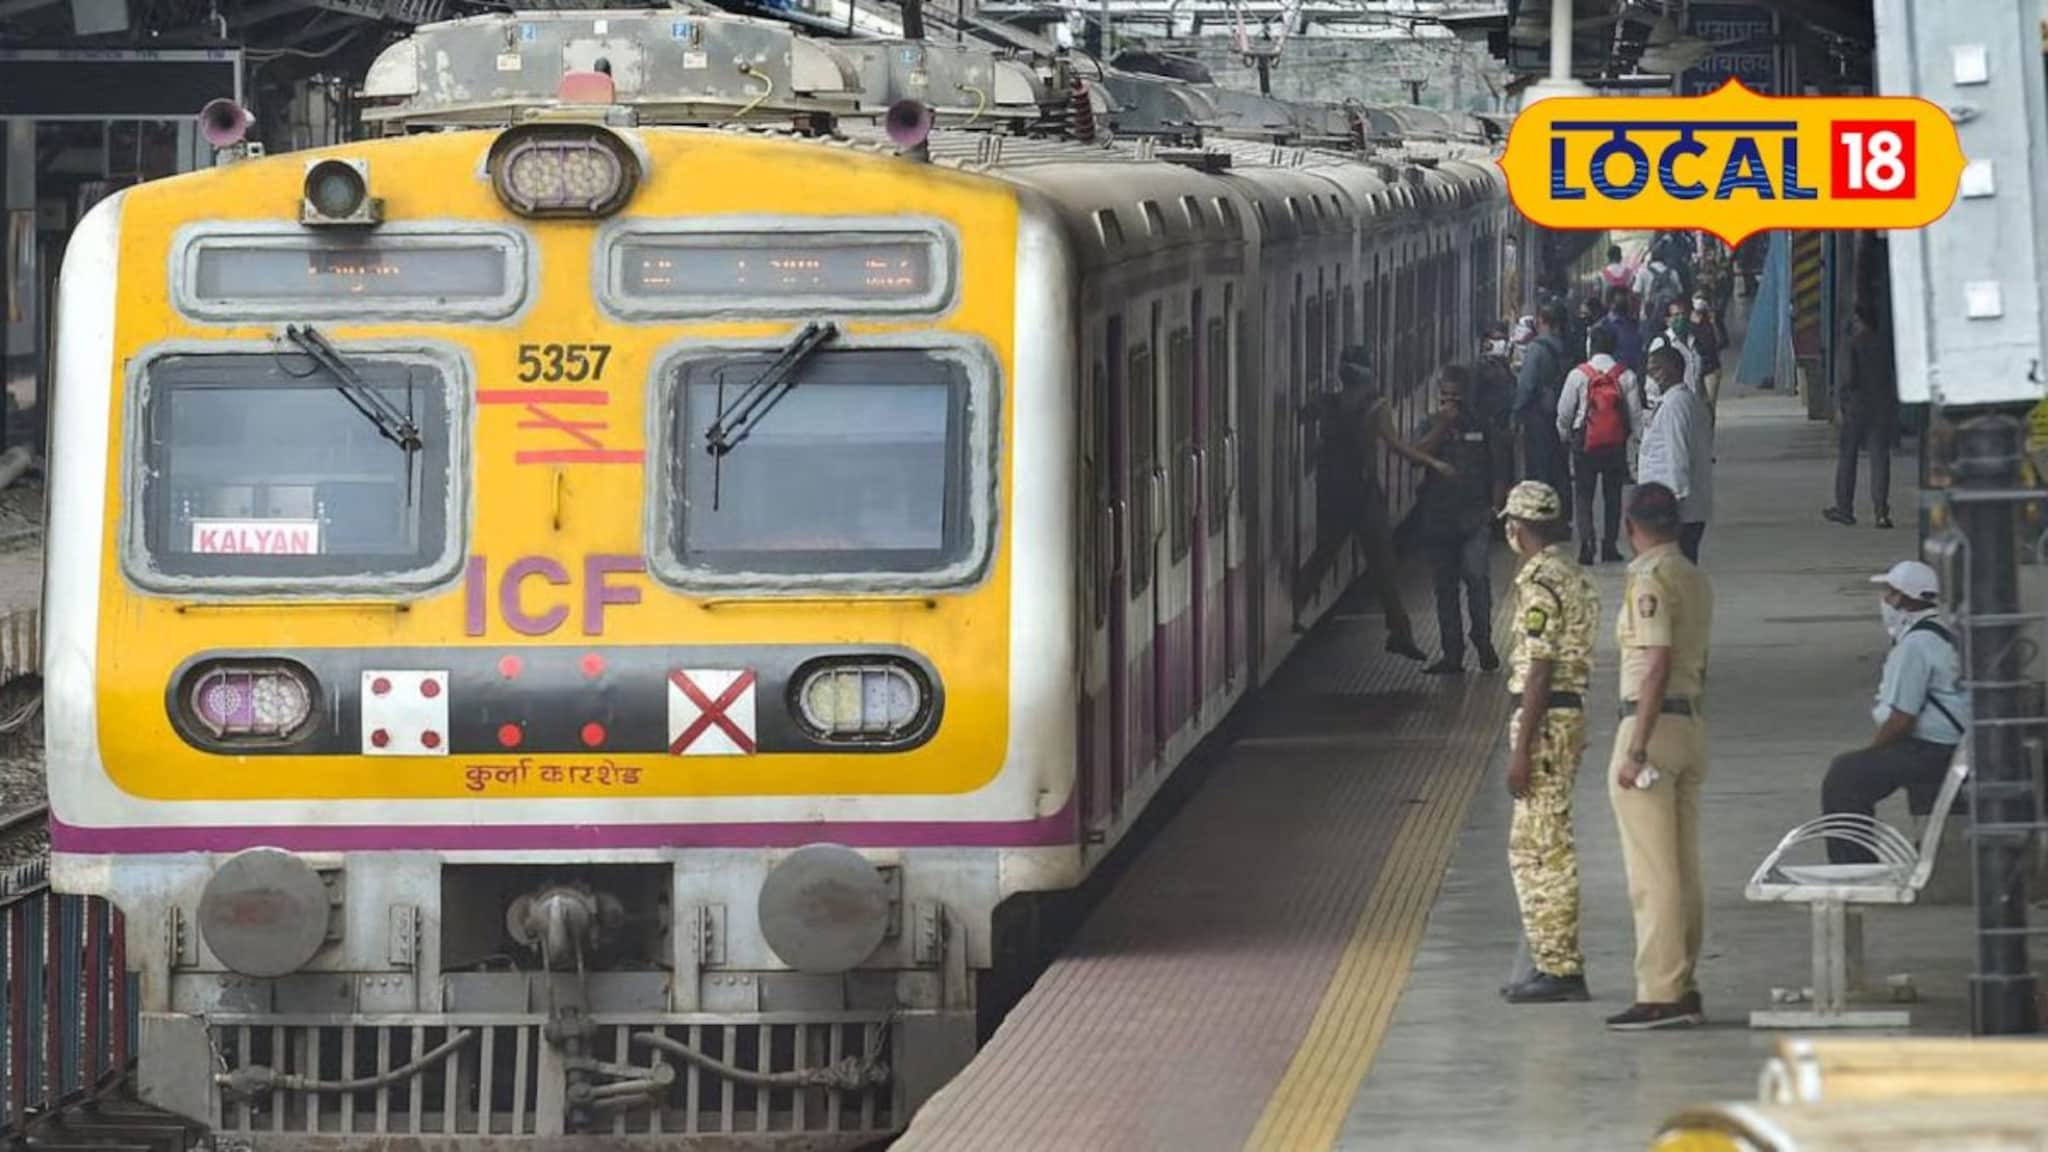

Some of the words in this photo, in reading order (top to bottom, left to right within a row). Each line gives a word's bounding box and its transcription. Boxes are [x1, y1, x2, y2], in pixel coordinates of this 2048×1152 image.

[517, 344, 612, 383] 5357
[199, 529, 310, 554] KALYAN
[464, 555, 648, 638] ICF
[465, 758, 533, 792] कुर्ला
[538, 759, 644, 786] कारशेड
